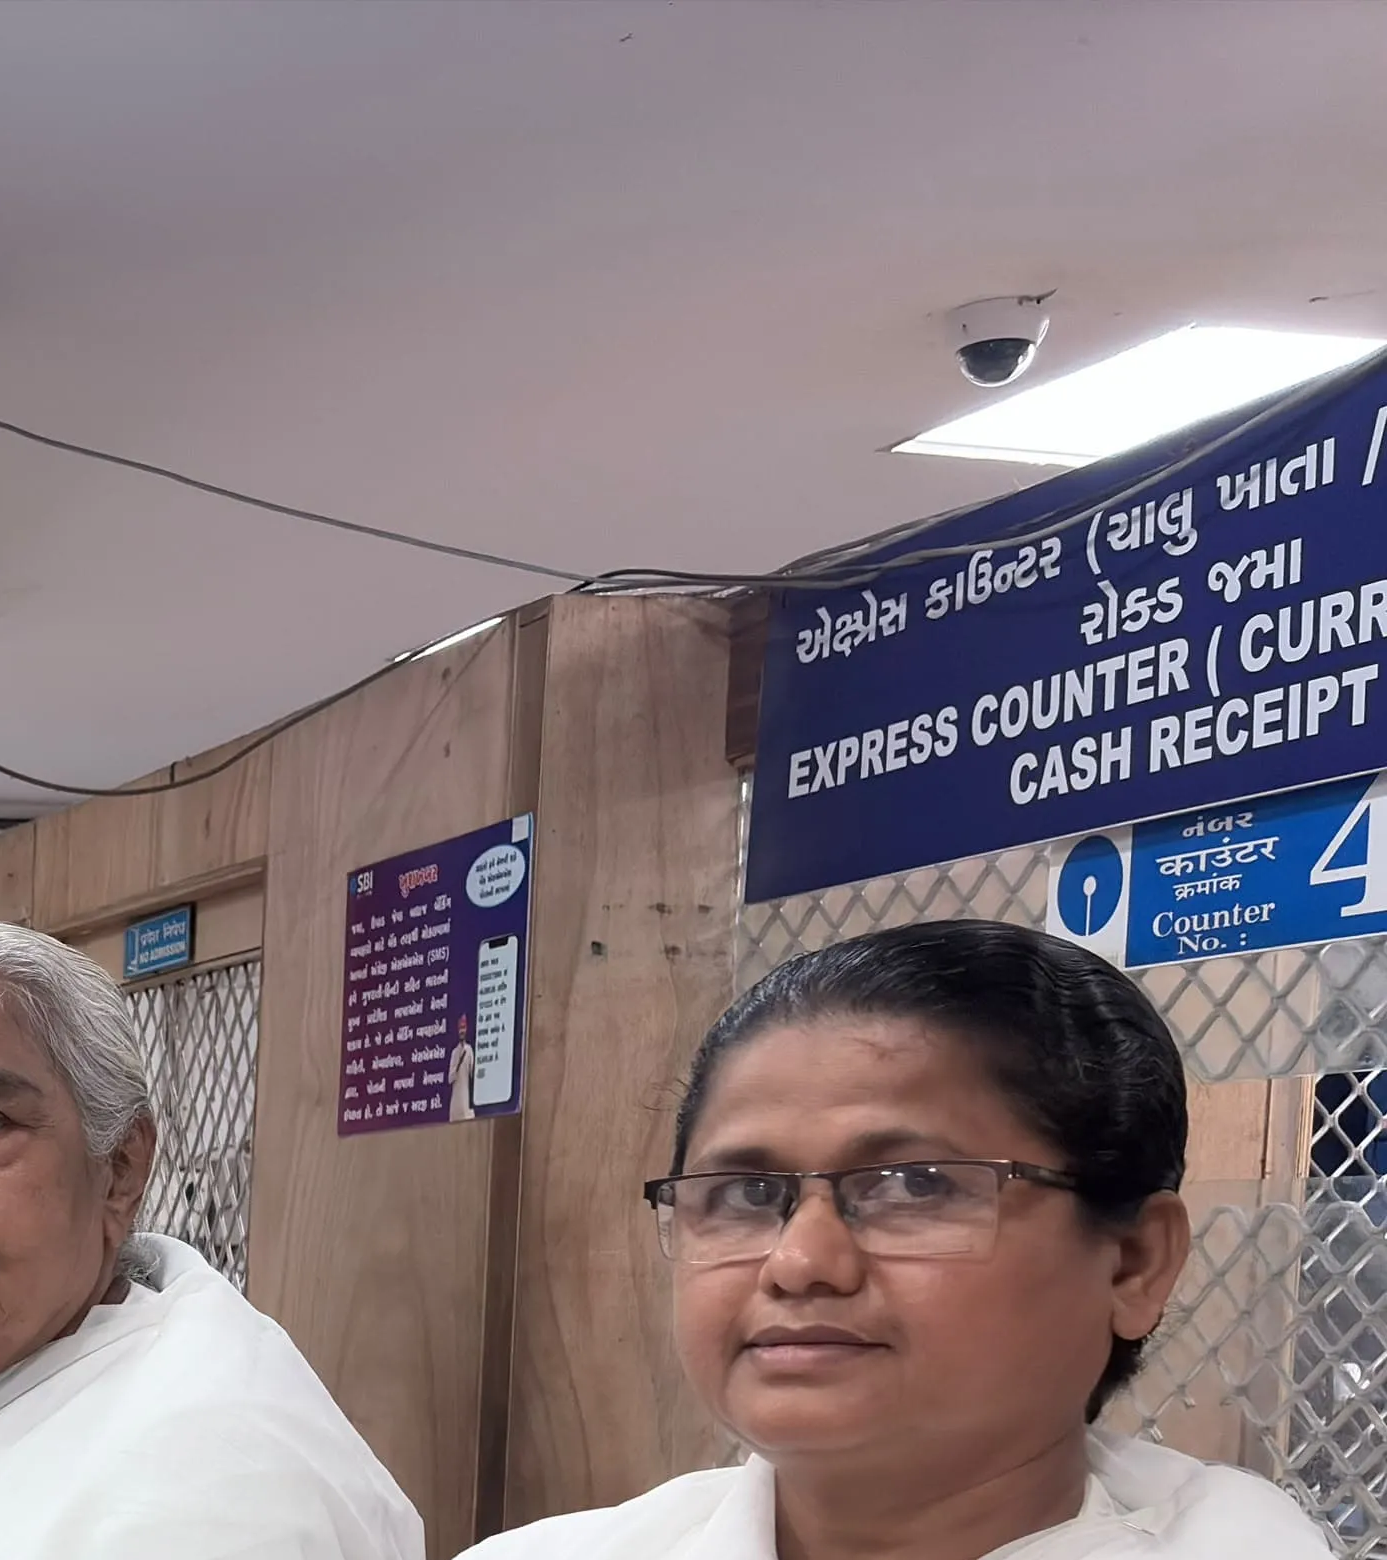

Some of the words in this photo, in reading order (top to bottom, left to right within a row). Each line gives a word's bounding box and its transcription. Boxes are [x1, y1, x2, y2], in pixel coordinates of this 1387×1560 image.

[925, 536, 1062, 620] કાઉન્ટર
[1216, 437, 1335, 510] ખાતા
[1080, 576, 1183, 646] રોકડ
[1208, 537, 1302, 603] જમા
[788, 712, 958, 799] EXPRESS
[971, 637, 1189, 747] COUNTER
[1239, 579, 1387, 673] CURR
[1010, 727, 1130, 805] CASH
[1149, 664, 1378, 774] RECEIPT
[1182, 812, 1254, 838] નંબર
[1155, 837, 1280, 877] काउंटर
[357, 871, 374, 894] SBI
[1172, 872, 1243, 902] क्रमांक
[1152, 902, 1276, 938] Counter
